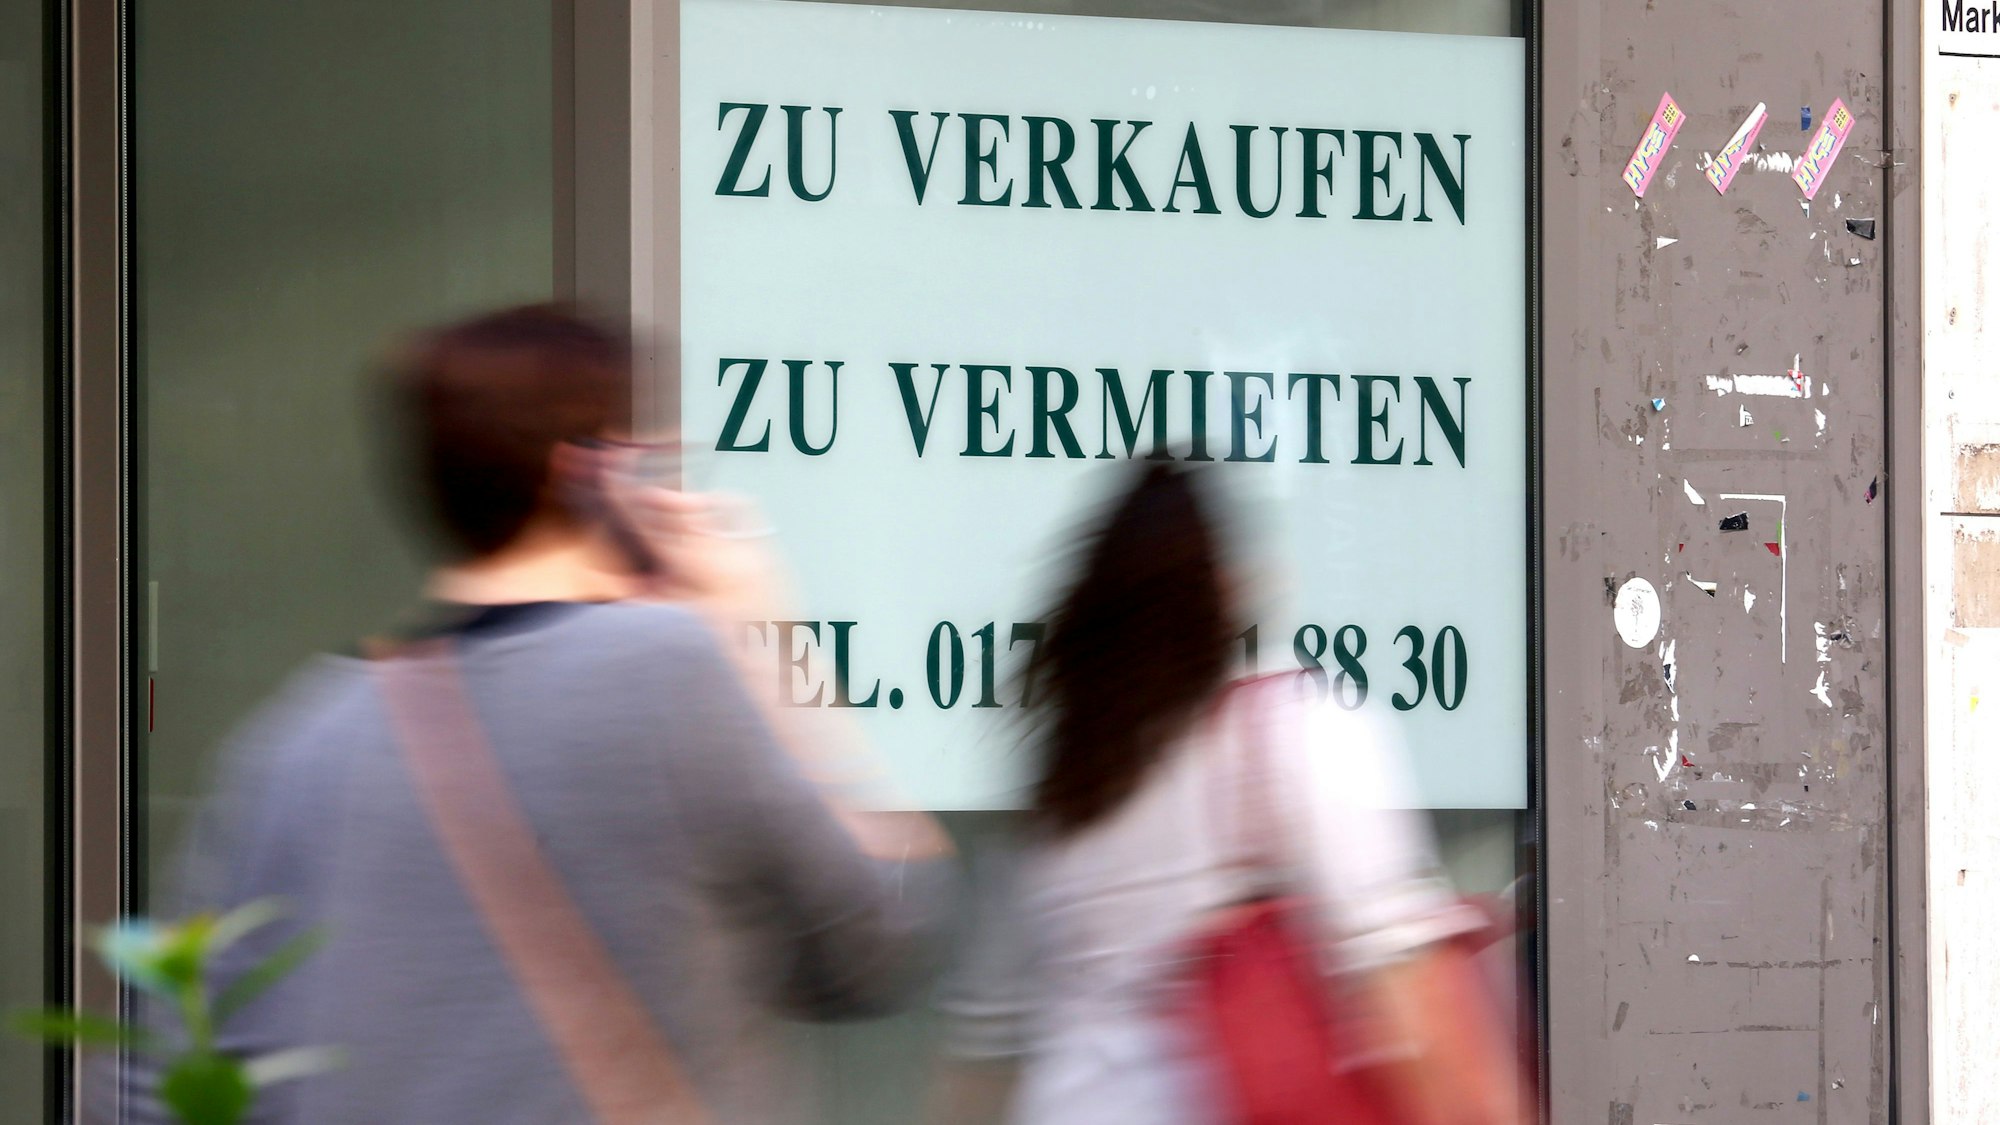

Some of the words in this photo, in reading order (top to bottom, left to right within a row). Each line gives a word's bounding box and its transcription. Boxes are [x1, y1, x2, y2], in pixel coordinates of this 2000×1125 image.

[715, 103, 843, 202] ZU
[888, 110, 1472, 226] VERKAUFEN
[715, 358, 845, 456] ZU
[888, 363, 1472, 469] VERMIETEN
[1293, 623, 1369, 711] 88
[1391, 625, 1468, 712] 30
